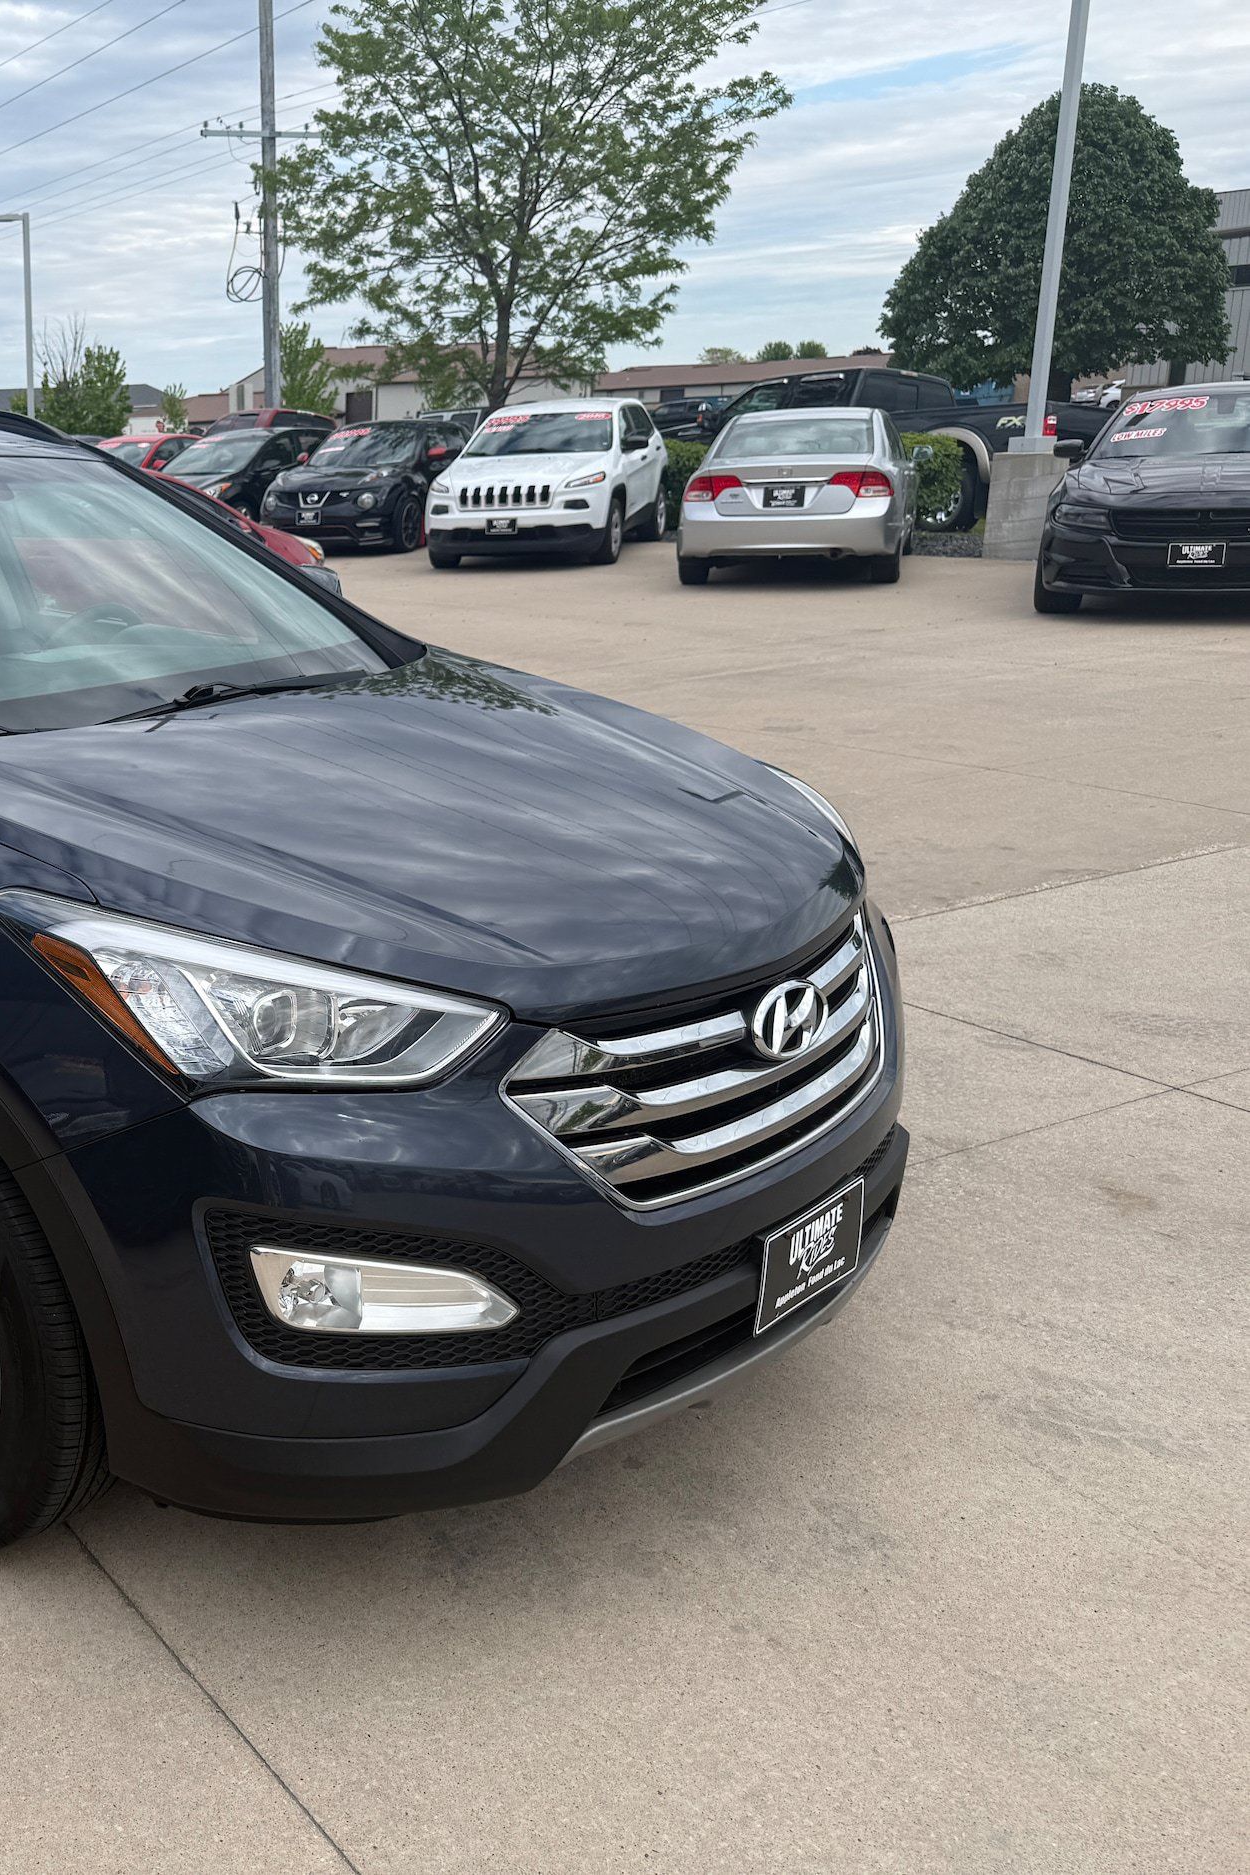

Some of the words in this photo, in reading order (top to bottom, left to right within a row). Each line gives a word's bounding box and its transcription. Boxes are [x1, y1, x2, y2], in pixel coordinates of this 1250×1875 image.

[1123, 396, 1210, 416] $17995
[1111, 431, 1134, 442] LOW
[1134, 428, 1166, 439] MILES
[1181, 545, 1213, 554] ULTIMATE
[789, 1203, 844, 1266] ULTIMATE
[775, 1284, 806, 1309] Appleton
[807, 1267, 825, 1287] Fond
[833, 1256, 846, 1271] Lac
